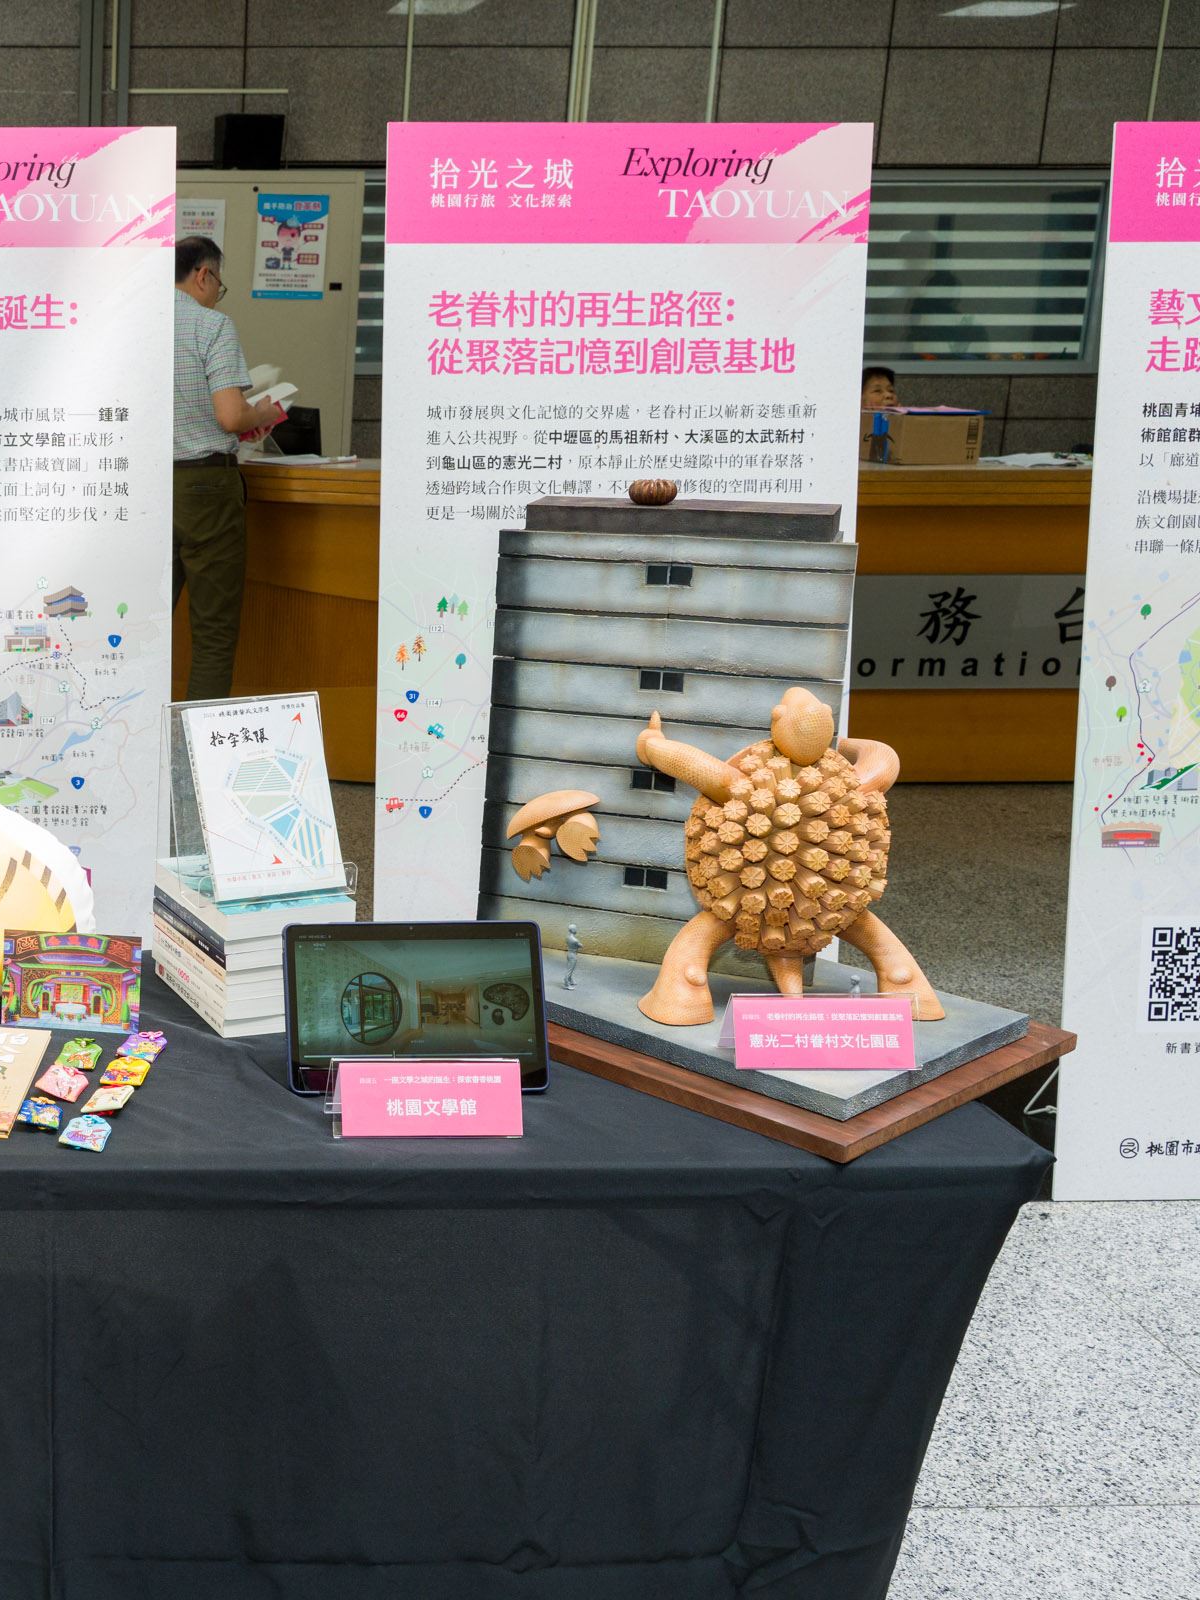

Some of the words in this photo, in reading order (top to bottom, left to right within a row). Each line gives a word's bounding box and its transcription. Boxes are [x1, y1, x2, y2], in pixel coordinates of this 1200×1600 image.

[429, 157, 575, 190] 拾光之城
[620, 146, 775, 184] Exploring
[430, 193, 496, 209] 桃園行旅
[507, 193, 573, 209] 文化探索
[658, 188, 851, 219] TAOYUAN
[427, 336, 797, 376] 從聚落記憶到創意基地
[1137, 489, 1200, 505] 沿機場捷
[1135, 514, 1200, 529] 族文創園
[748, 1033, 900, 1049] 憲光二村眷村文化園區
[386, 1098, 478, 1117] 桃園文學館
